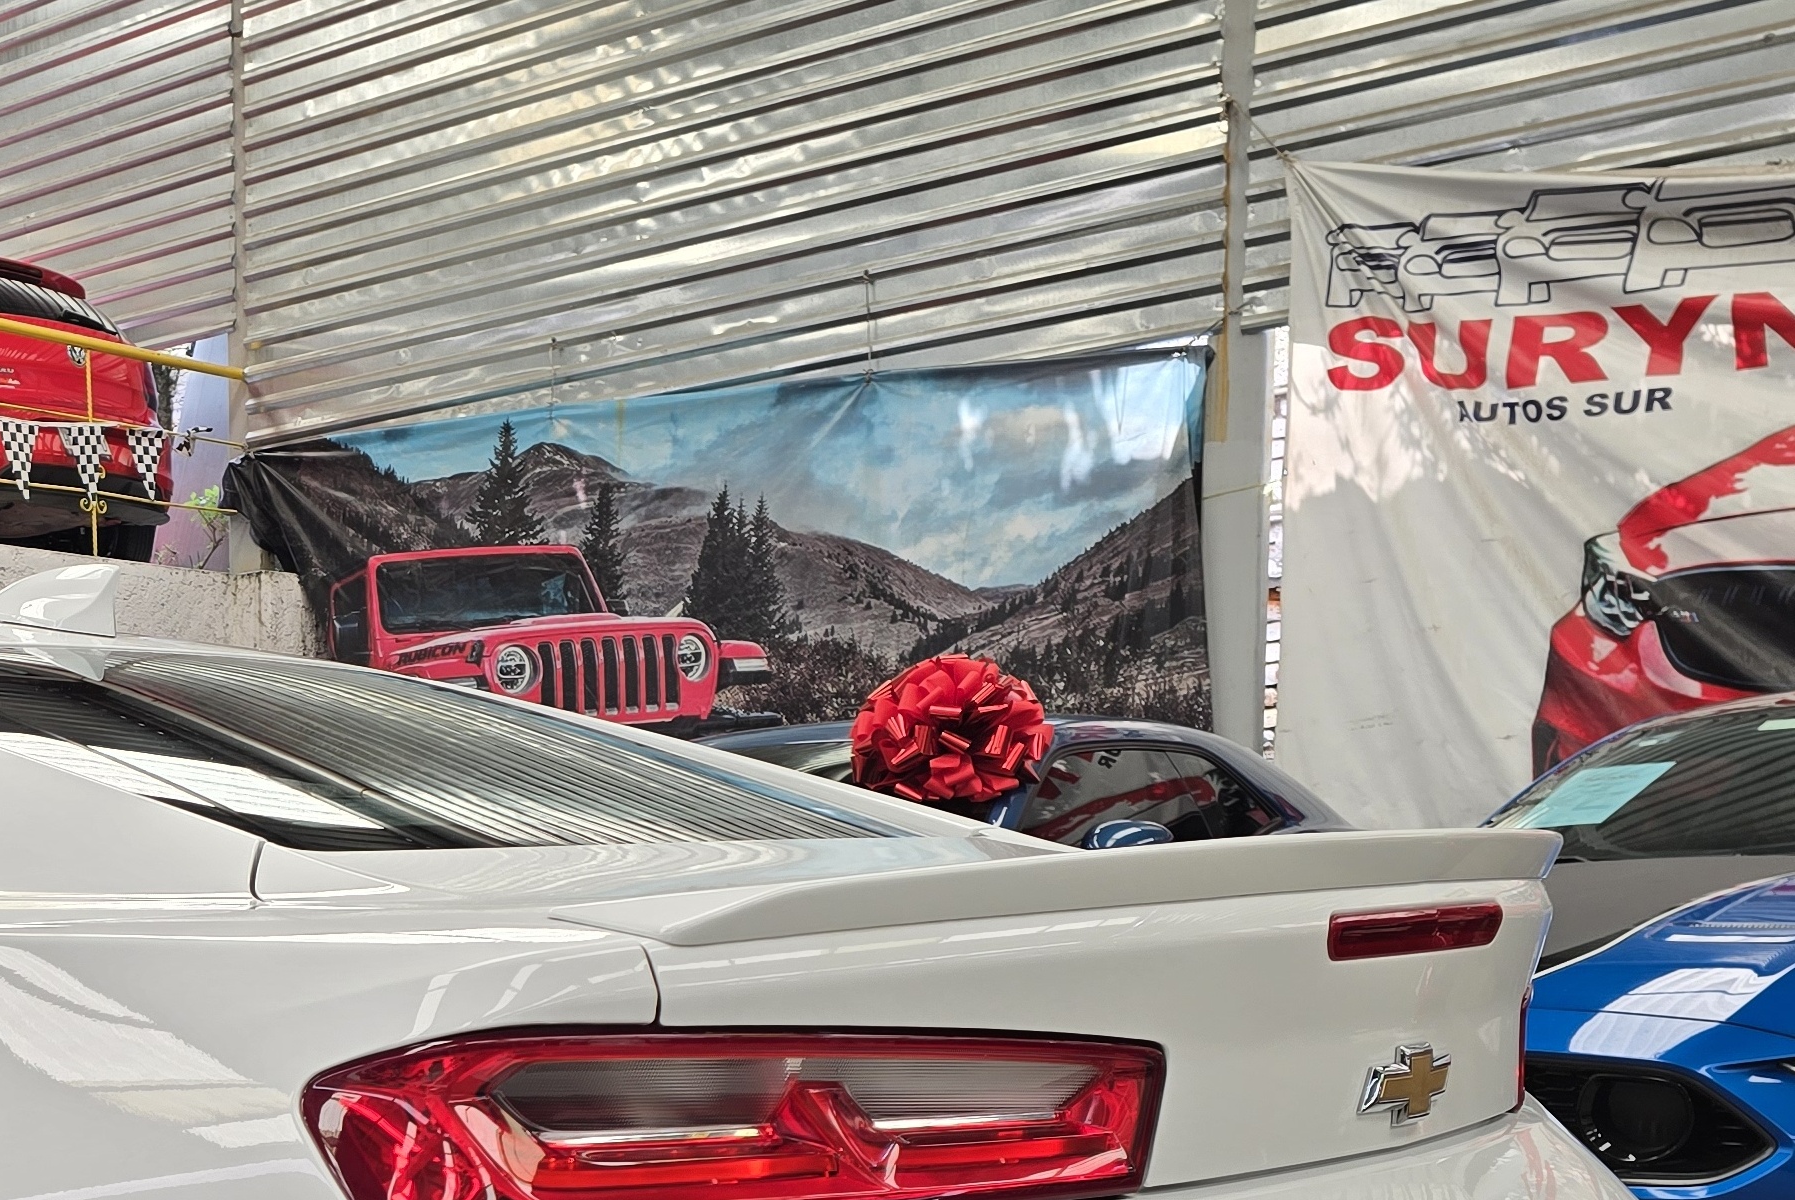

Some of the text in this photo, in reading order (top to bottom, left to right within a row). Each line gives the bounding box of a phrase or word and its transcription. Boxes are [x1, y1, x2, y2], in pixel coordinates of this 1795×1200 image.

[1458, 387, 1674, 425] AUTOS SUR
[397, 642, 467, 665] RUBICON
